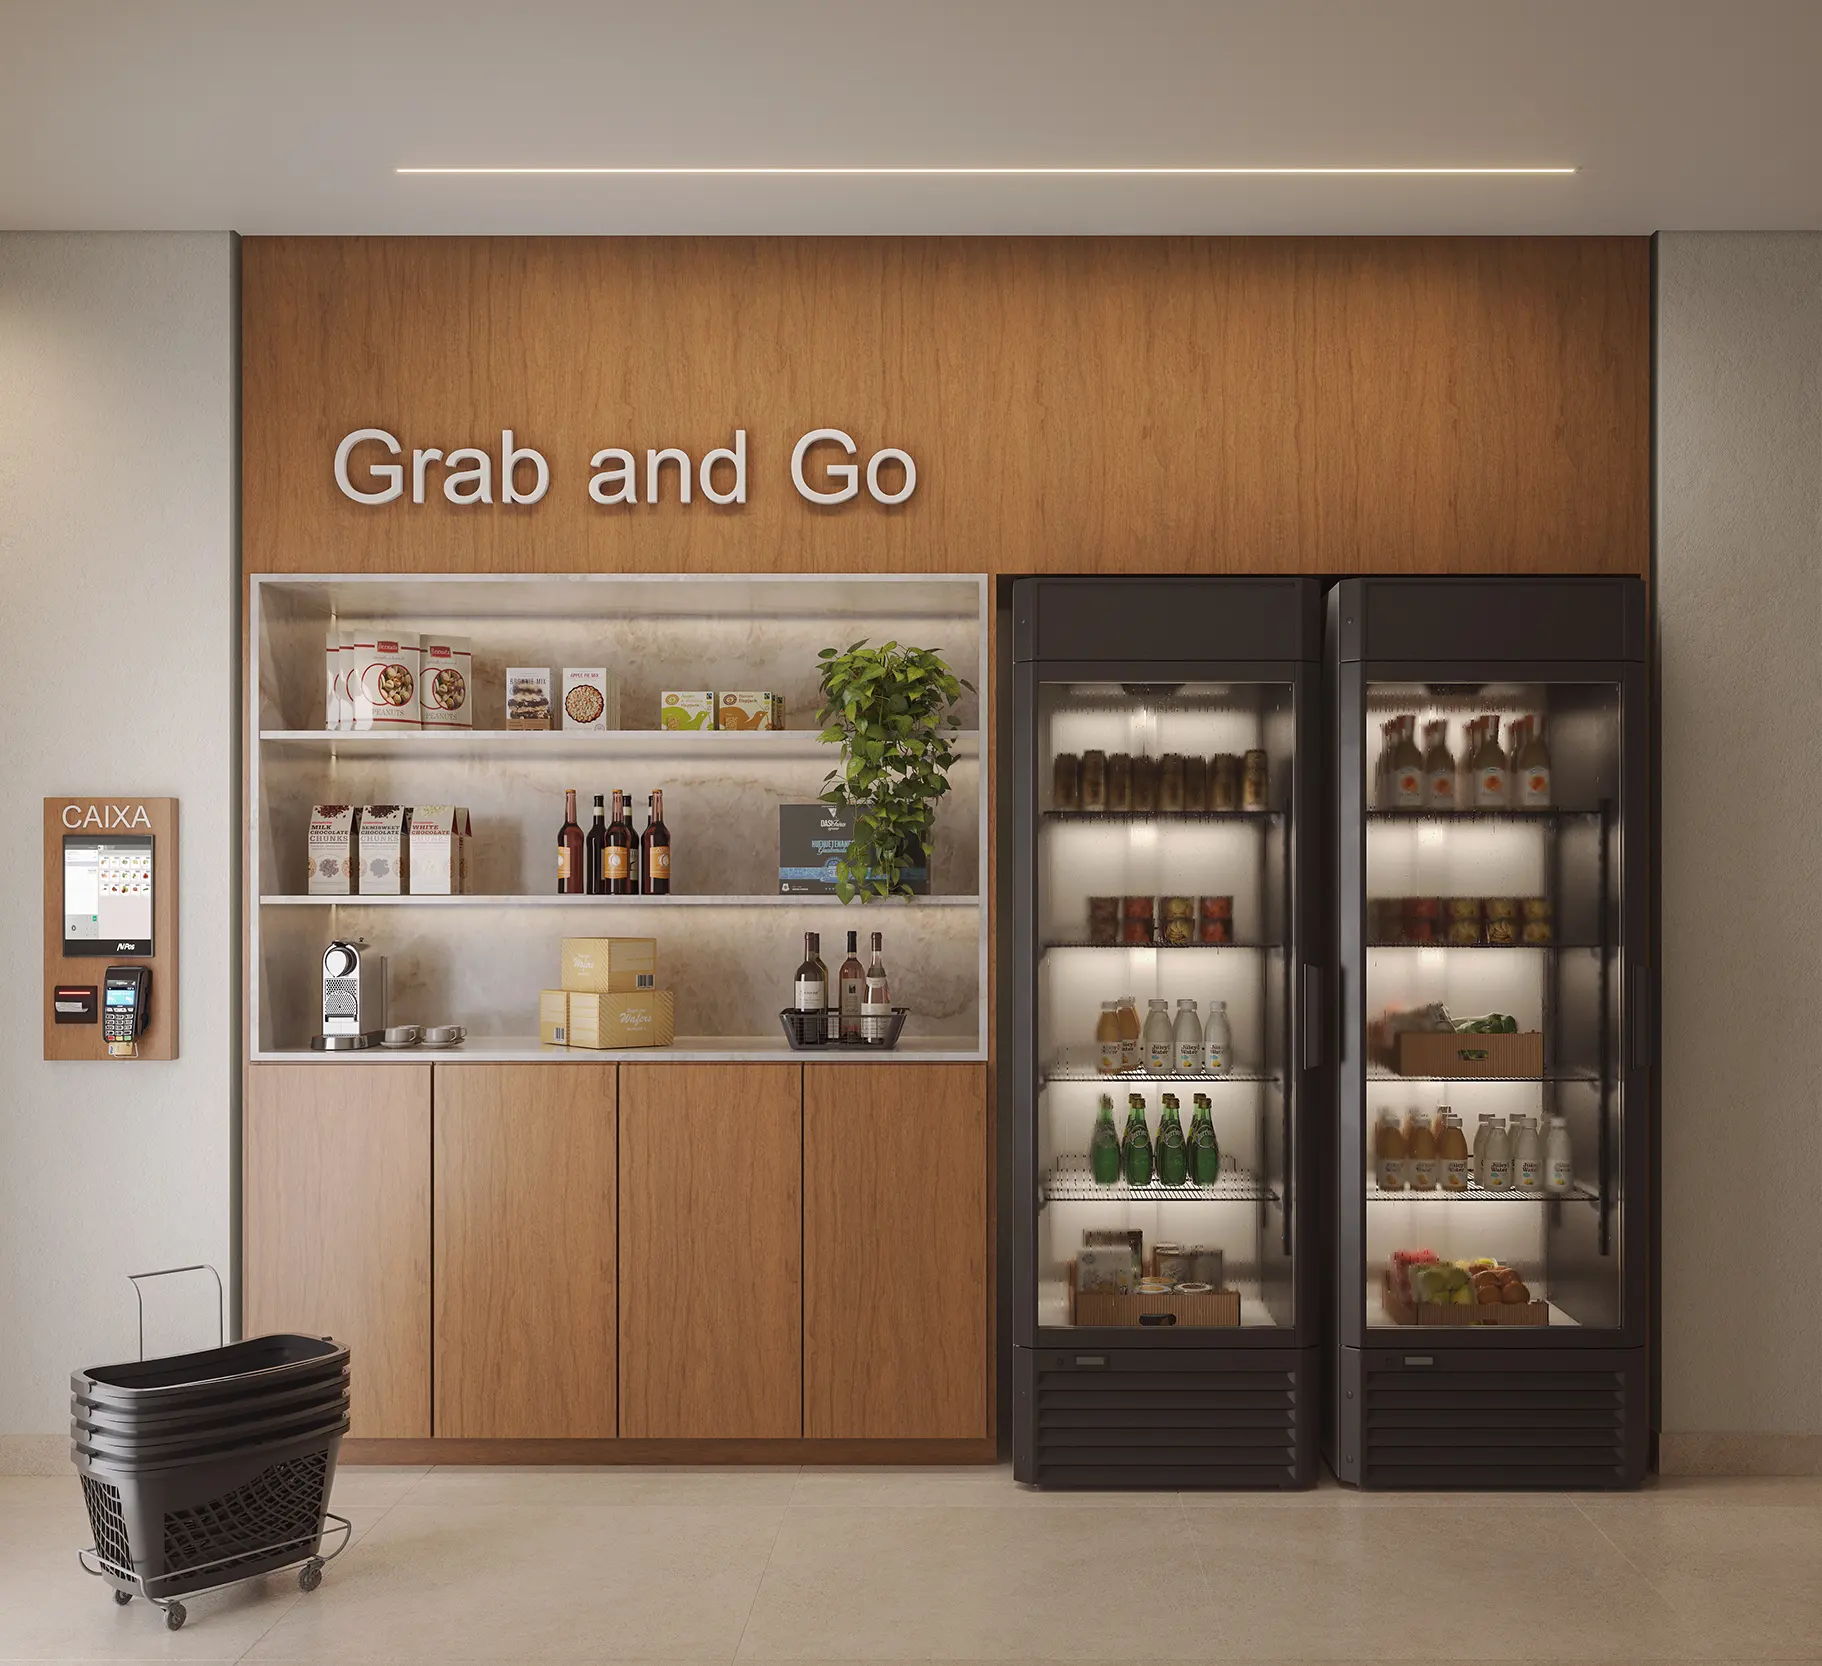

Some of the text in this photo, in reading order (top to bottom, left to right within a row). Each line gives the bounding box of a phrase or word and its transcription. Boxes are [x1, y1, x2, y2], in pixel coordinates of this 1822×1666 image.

[334, 428, 917, 505] Grab and Go
[510, 677, 547, 685] BROWNIE MIX
[62, 804, 151, 829] CAIXA
[619, 1011, 653, 1027] Wafers
